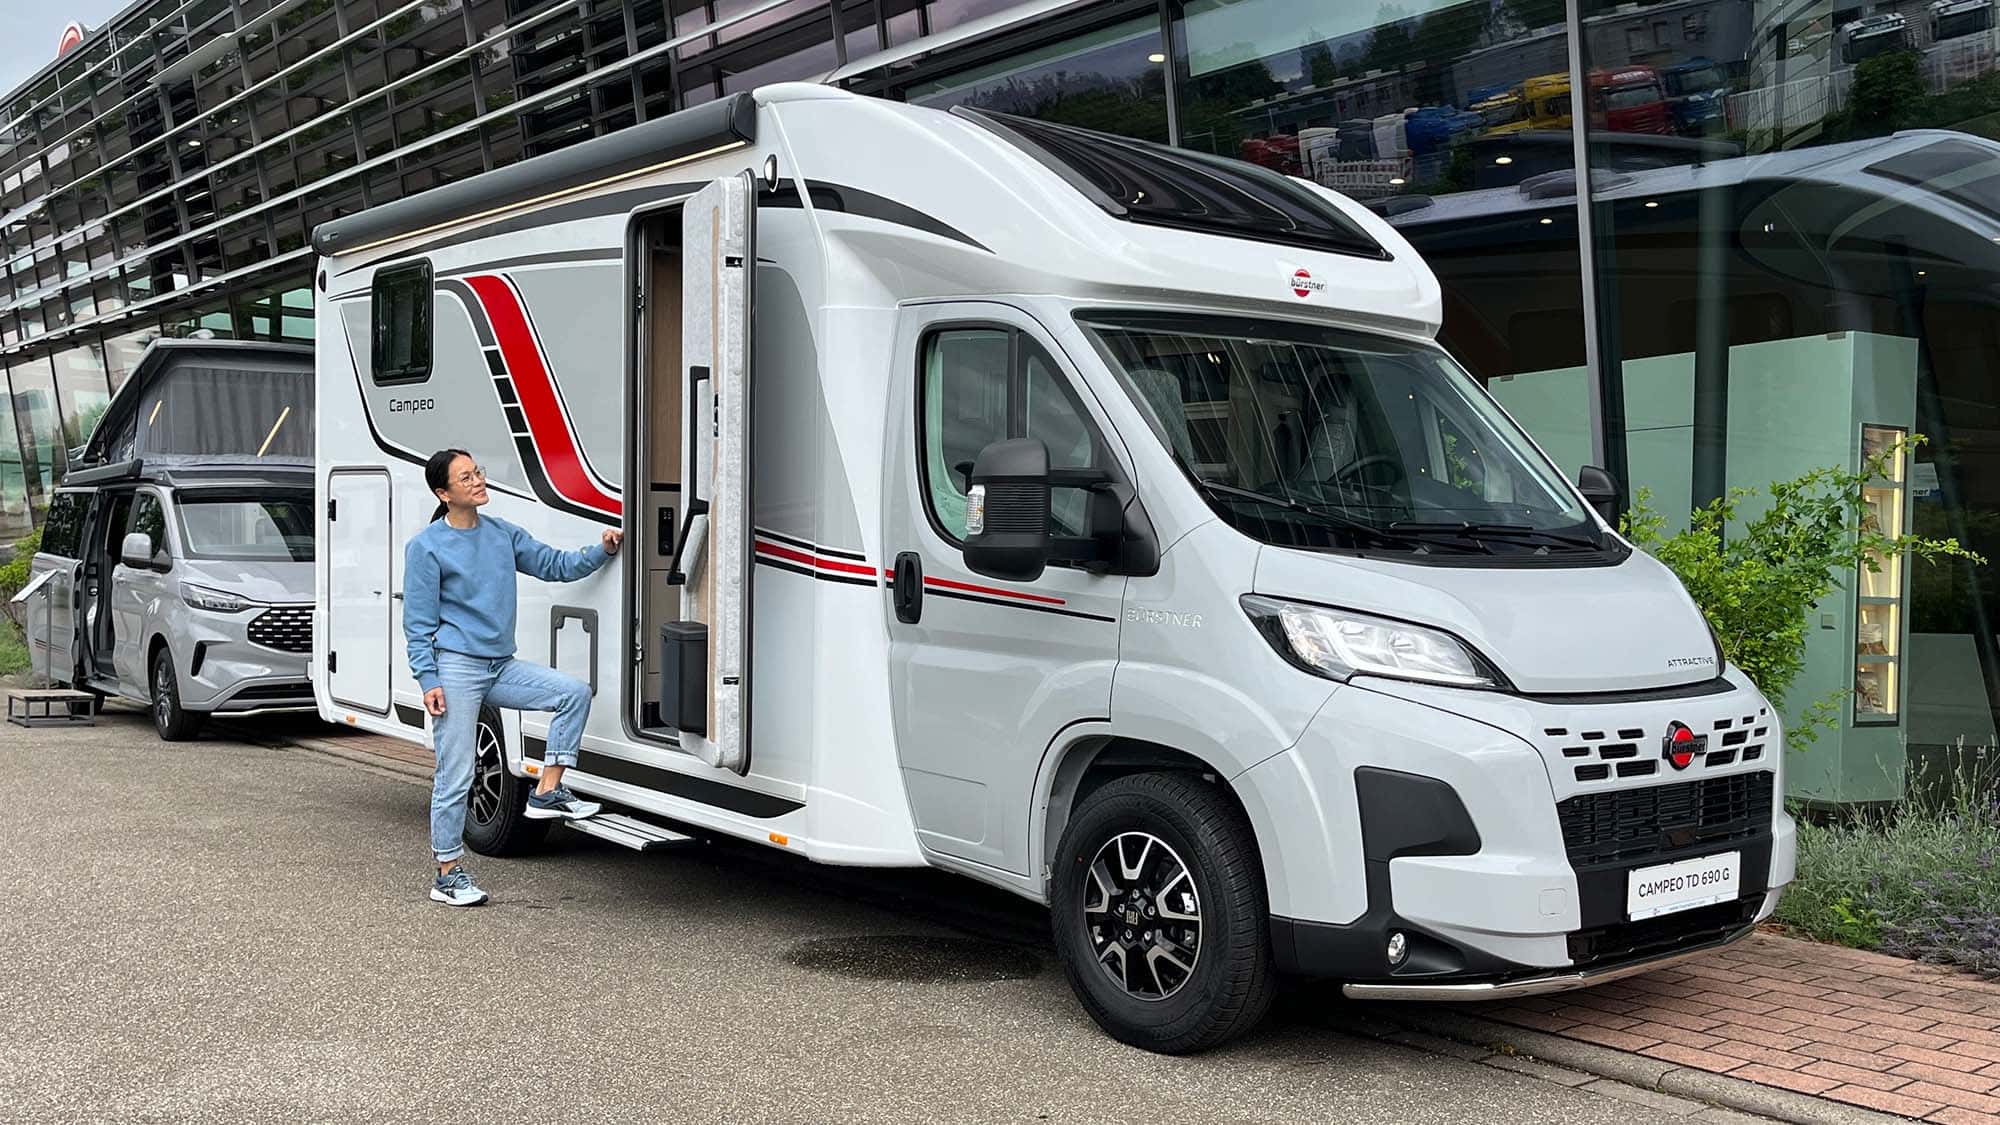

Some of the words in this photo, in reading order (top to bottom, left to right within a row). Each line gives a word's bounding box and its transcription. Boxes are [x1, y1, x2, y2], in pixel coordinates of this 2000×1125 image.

[1291, 277, 1325, 291] bürstner
[390, 399, 434, 414] Campeo
[1668, 656, 1714, 667] ATTRACTIVE
[1638, 876, 1684, 898] CAMPEO
[1686, 873, 1700, 889] TD
[1701, 868, 1721, 886] 690
[1722, 867, 1730, 881] G
